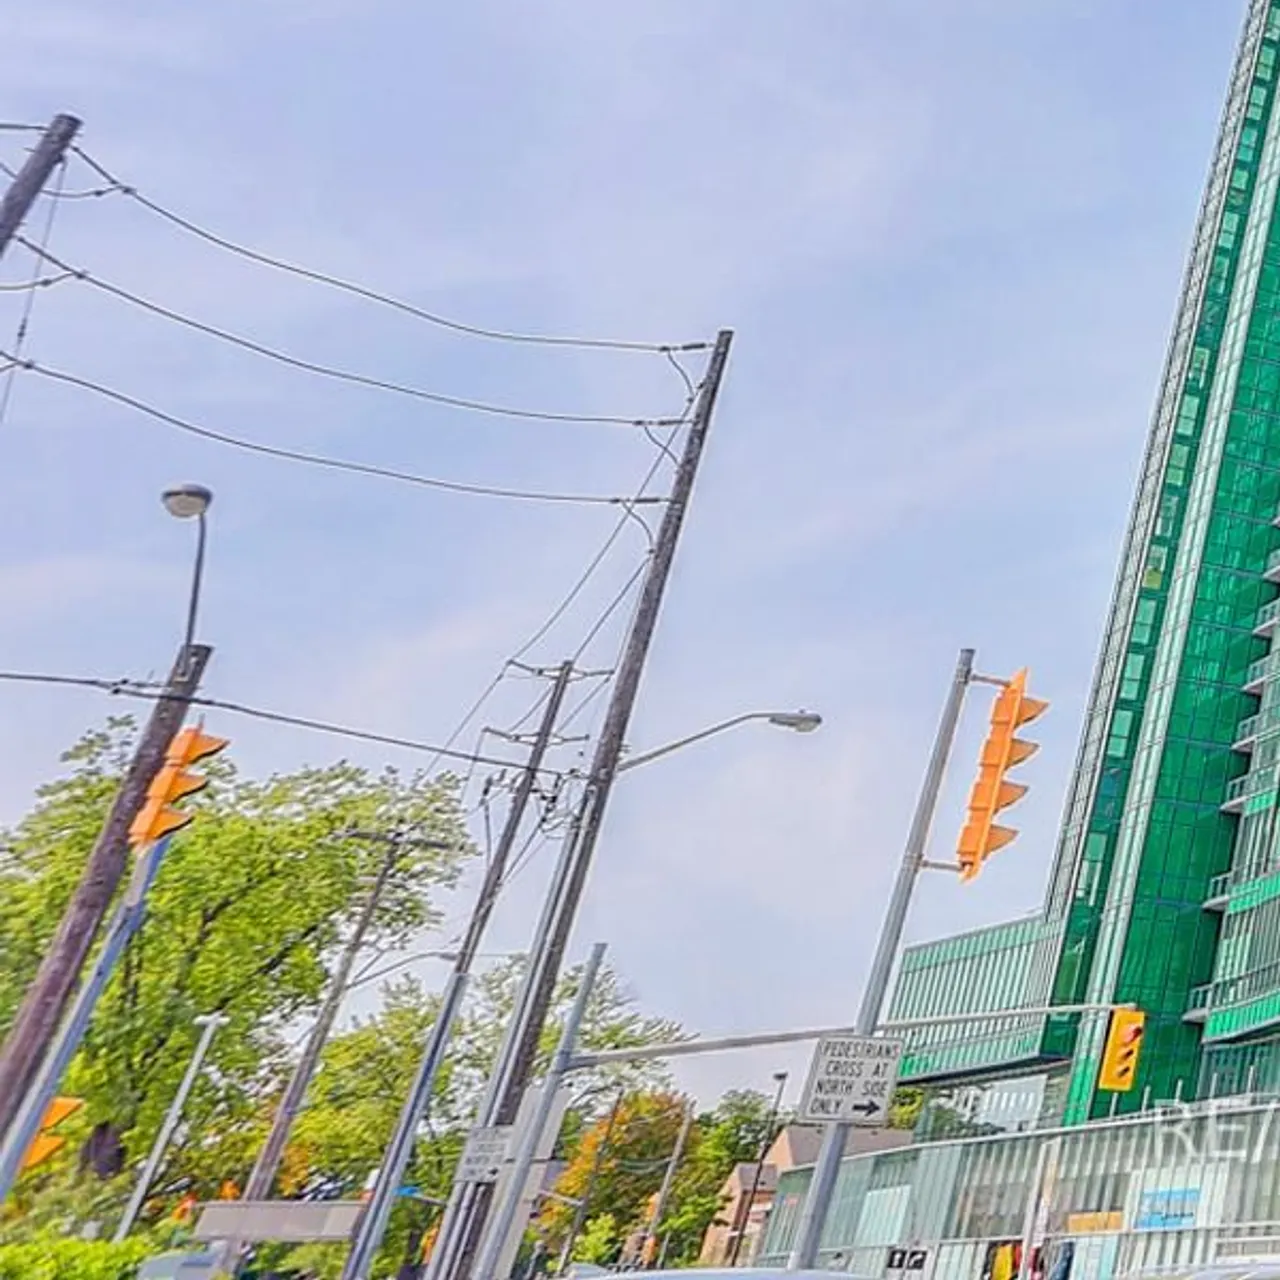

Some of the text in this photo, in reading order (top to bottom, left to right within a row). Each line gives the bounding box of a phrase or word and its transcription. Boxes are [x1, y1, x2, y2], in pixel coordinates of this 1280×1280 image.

[825, 1060, 889, 1077] CROSS AT
[861, 1080, 888, 1097] SIDE
[810, 1098, 844, 1114] ONLY
